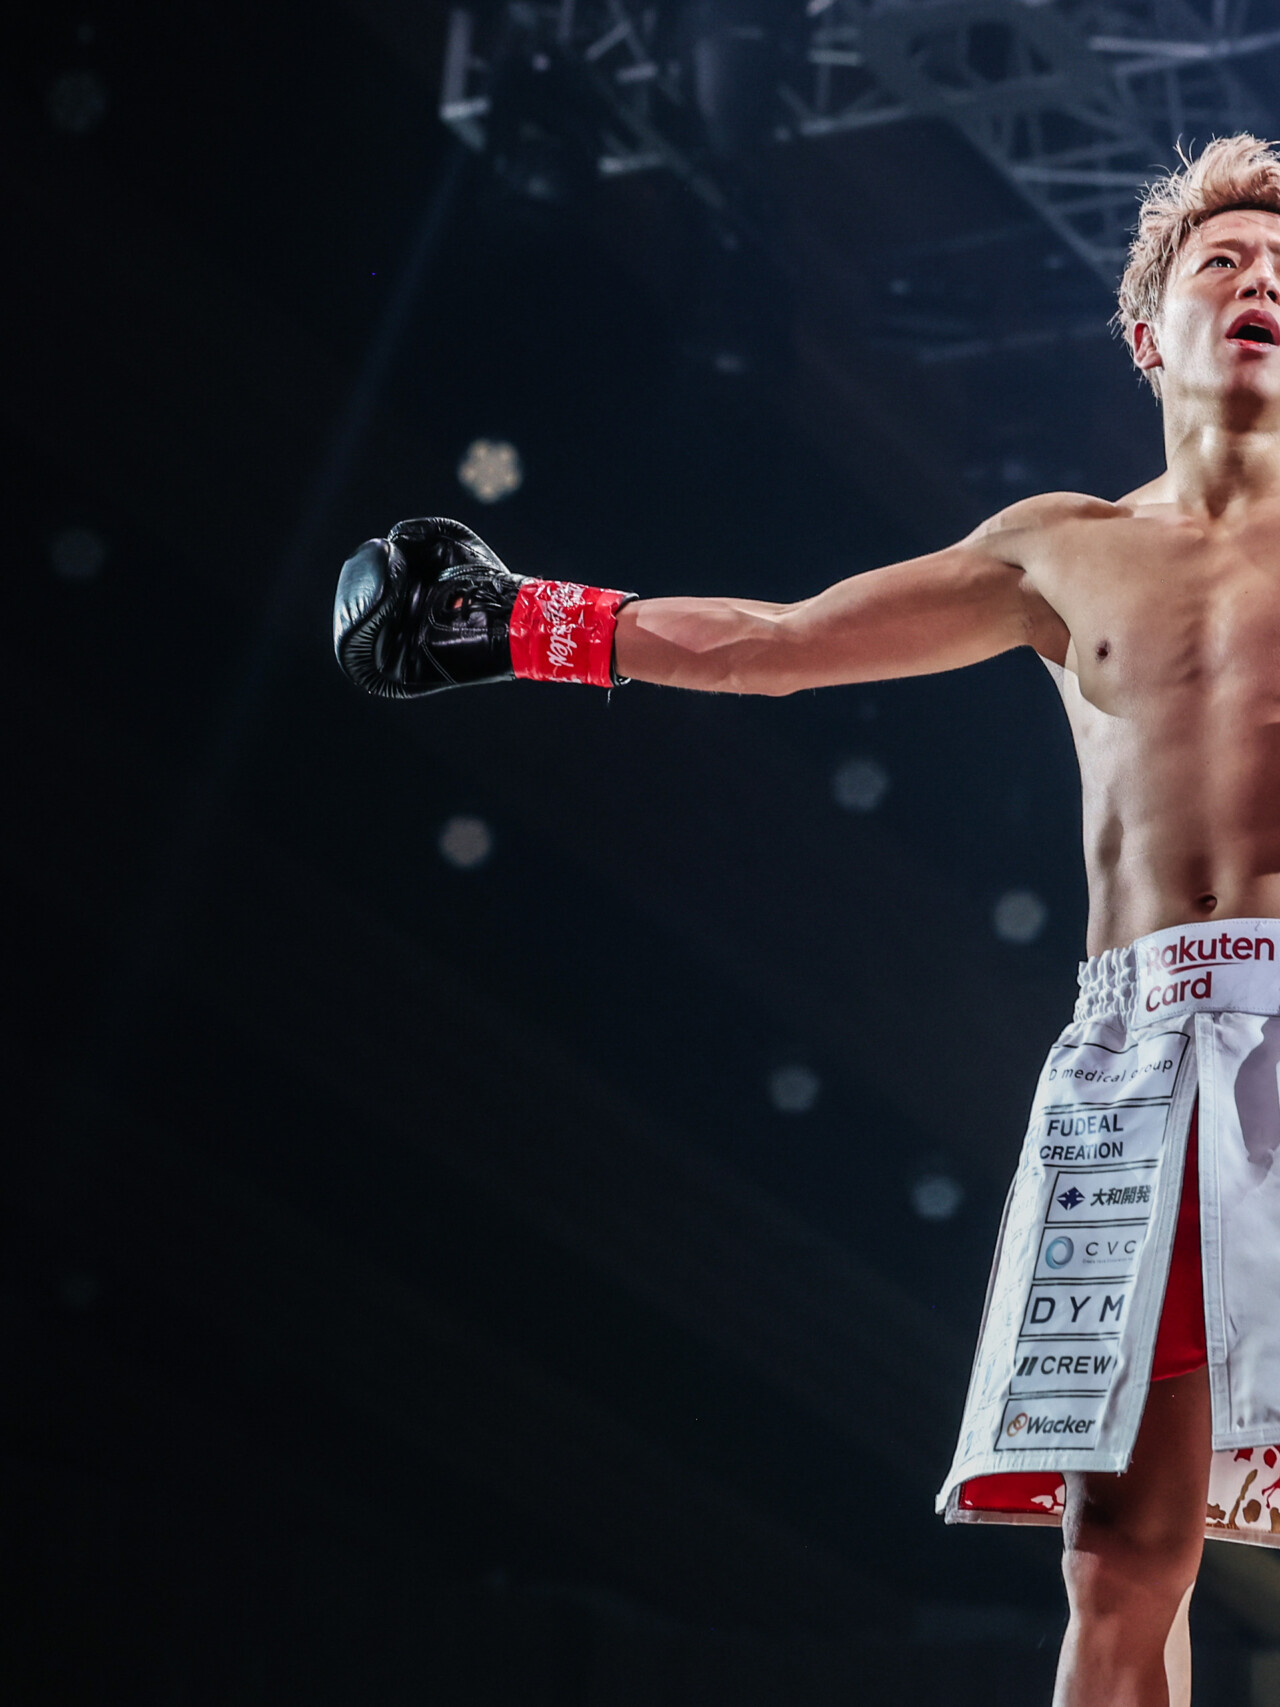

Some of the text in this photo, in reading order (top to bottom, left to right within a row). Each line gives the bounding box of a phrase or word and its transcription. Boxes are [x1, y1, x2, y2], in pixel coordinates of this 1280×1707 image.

[1146, 933, 1274, 976] Rakuten
[1062, 1068, 1126, 1082] medical
[1131, 1059, 1173, 1082] goup
[1047, 1114, 1123, 1136] FUDEAL
[1040, 1142, 1123, 1160] CREATION
[1090, 1185, 1151, 1206] 大和開発
[1030, 1294, 1125, 1324] DYM
[1040, 1355, 1111, 1375] CREW
[1027, 1415, 1096, 1434] Wacker
